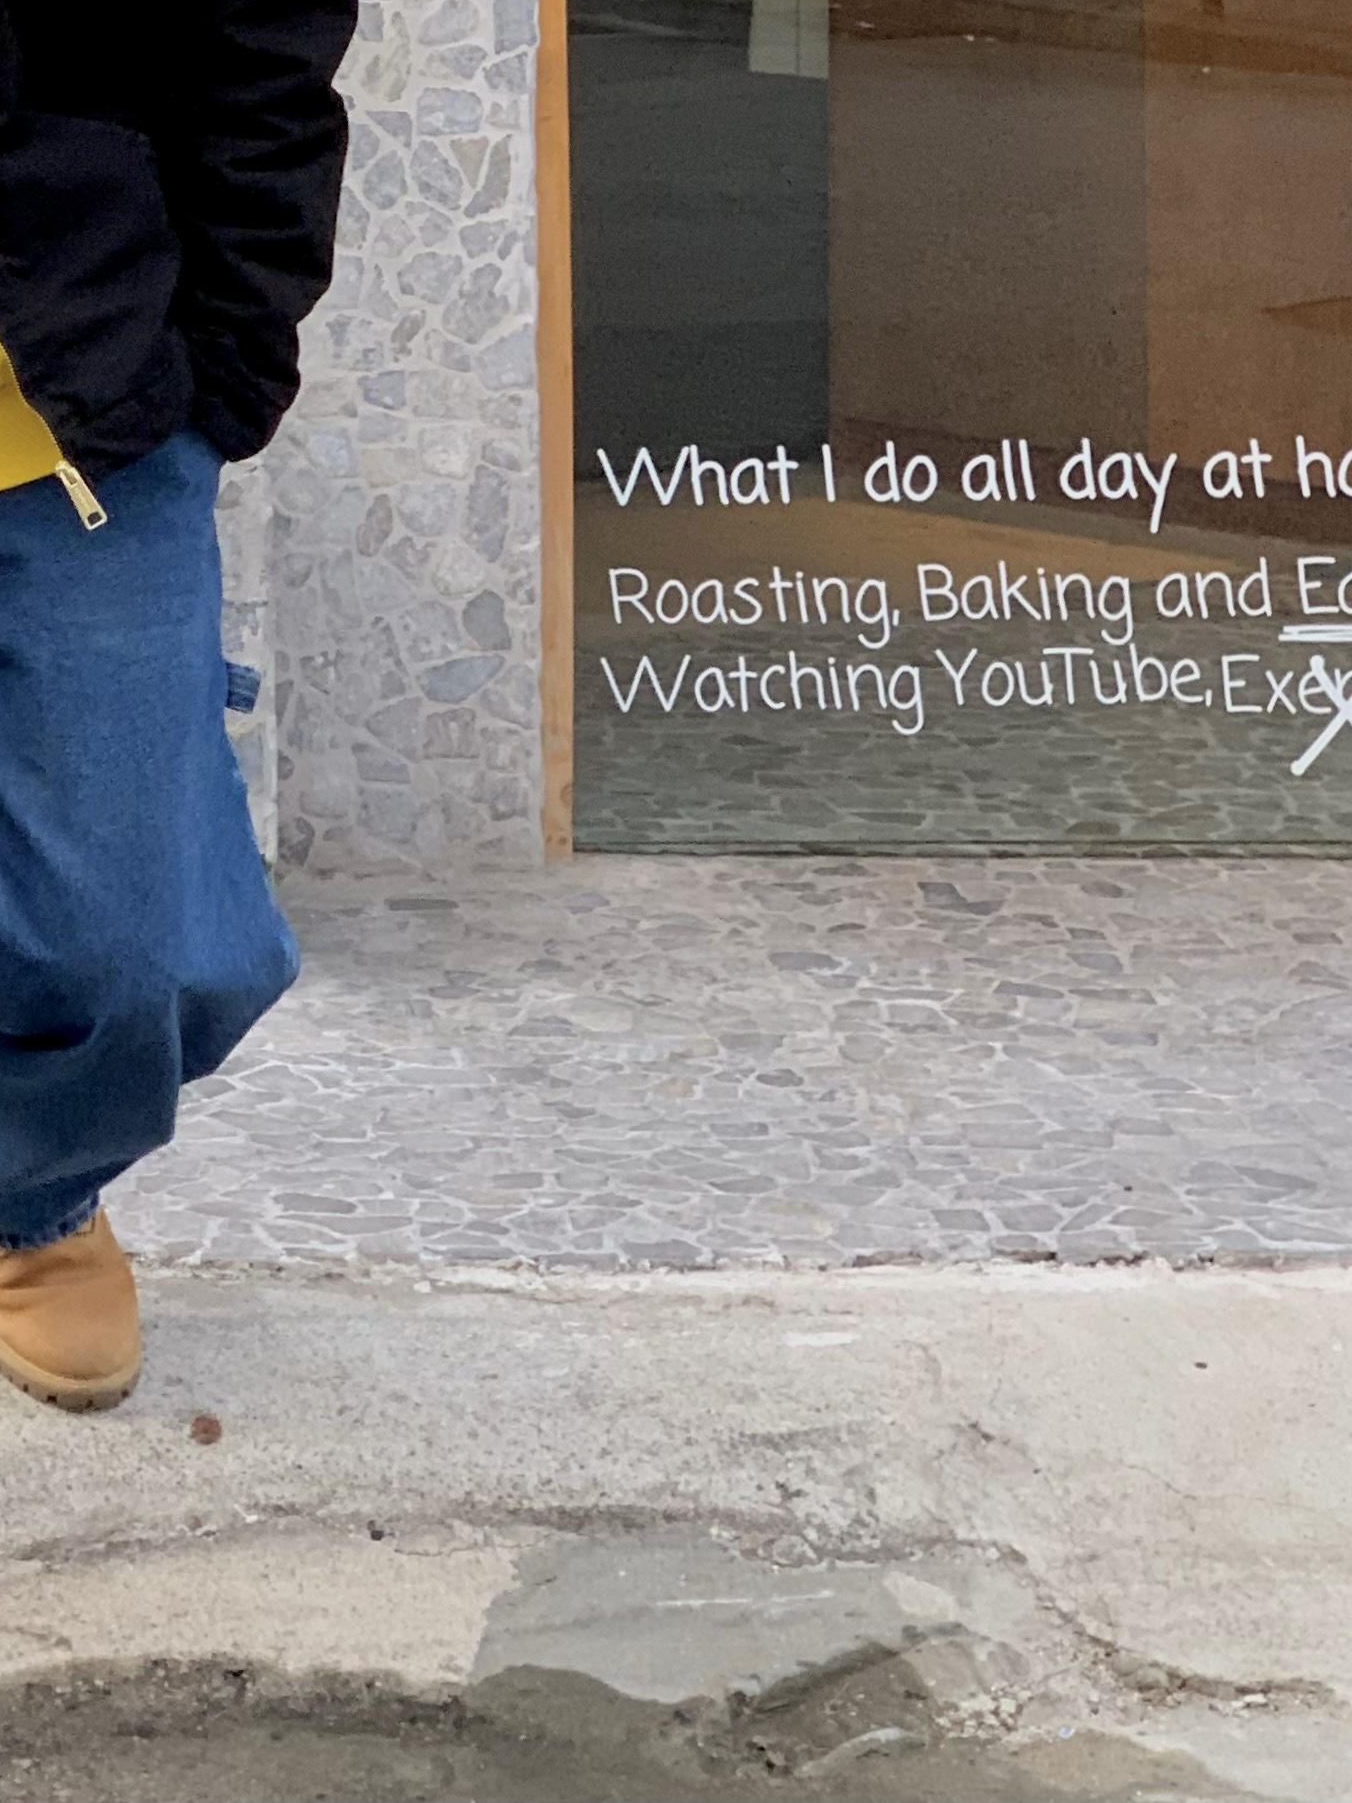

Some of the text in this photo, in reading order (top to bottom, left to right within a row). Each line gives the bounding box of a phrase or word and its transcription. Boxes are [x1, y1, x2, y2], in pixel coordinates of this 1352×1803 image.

[596, 442, 800, 507] What
[821, 442, 837, 503] I
[862, 439, 940, 503] do
[959, 437, 1037, 503] all
[1058, 436, 1179, 534] day
[1201, 437, 1274, 500] at
[608, 565, 902, 650] Roasting,
[915, 560, 1136, 646] Baking
[1154, 555, 1274, 619] and
[599, 649, 926, 736] Watching
